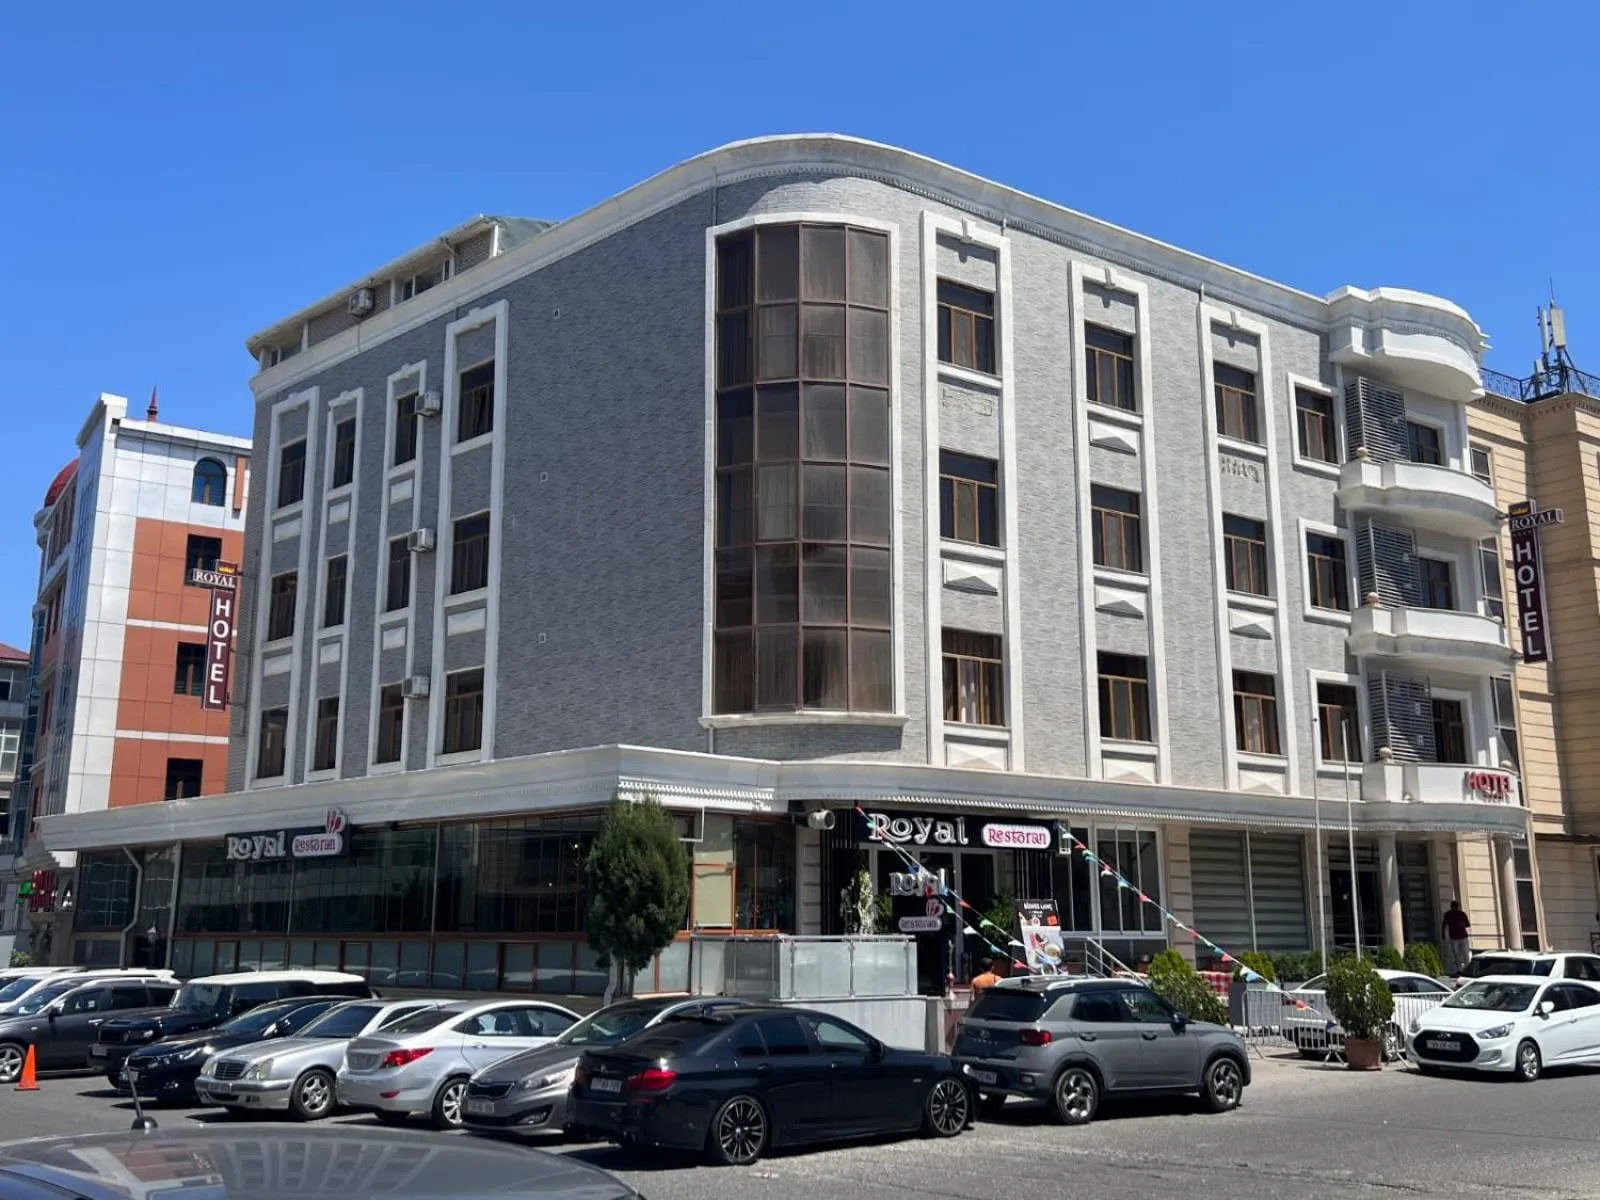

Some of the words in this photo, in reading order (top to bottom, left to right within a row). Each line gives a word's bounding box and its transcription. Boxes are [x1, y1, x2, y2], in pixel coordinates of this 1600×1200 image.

[1511, 511, 1556, 530] ROYAL
[195, 570, 236, 588] ROYAL
[1515, 541, 1541, 655] HOTEL
[209, 597, 231, 705] HOTEL
[226, 830, 287, 860] Royal
[867, 812, 969, 846] Royal
[987, 828, 1047, 846] Restoran
